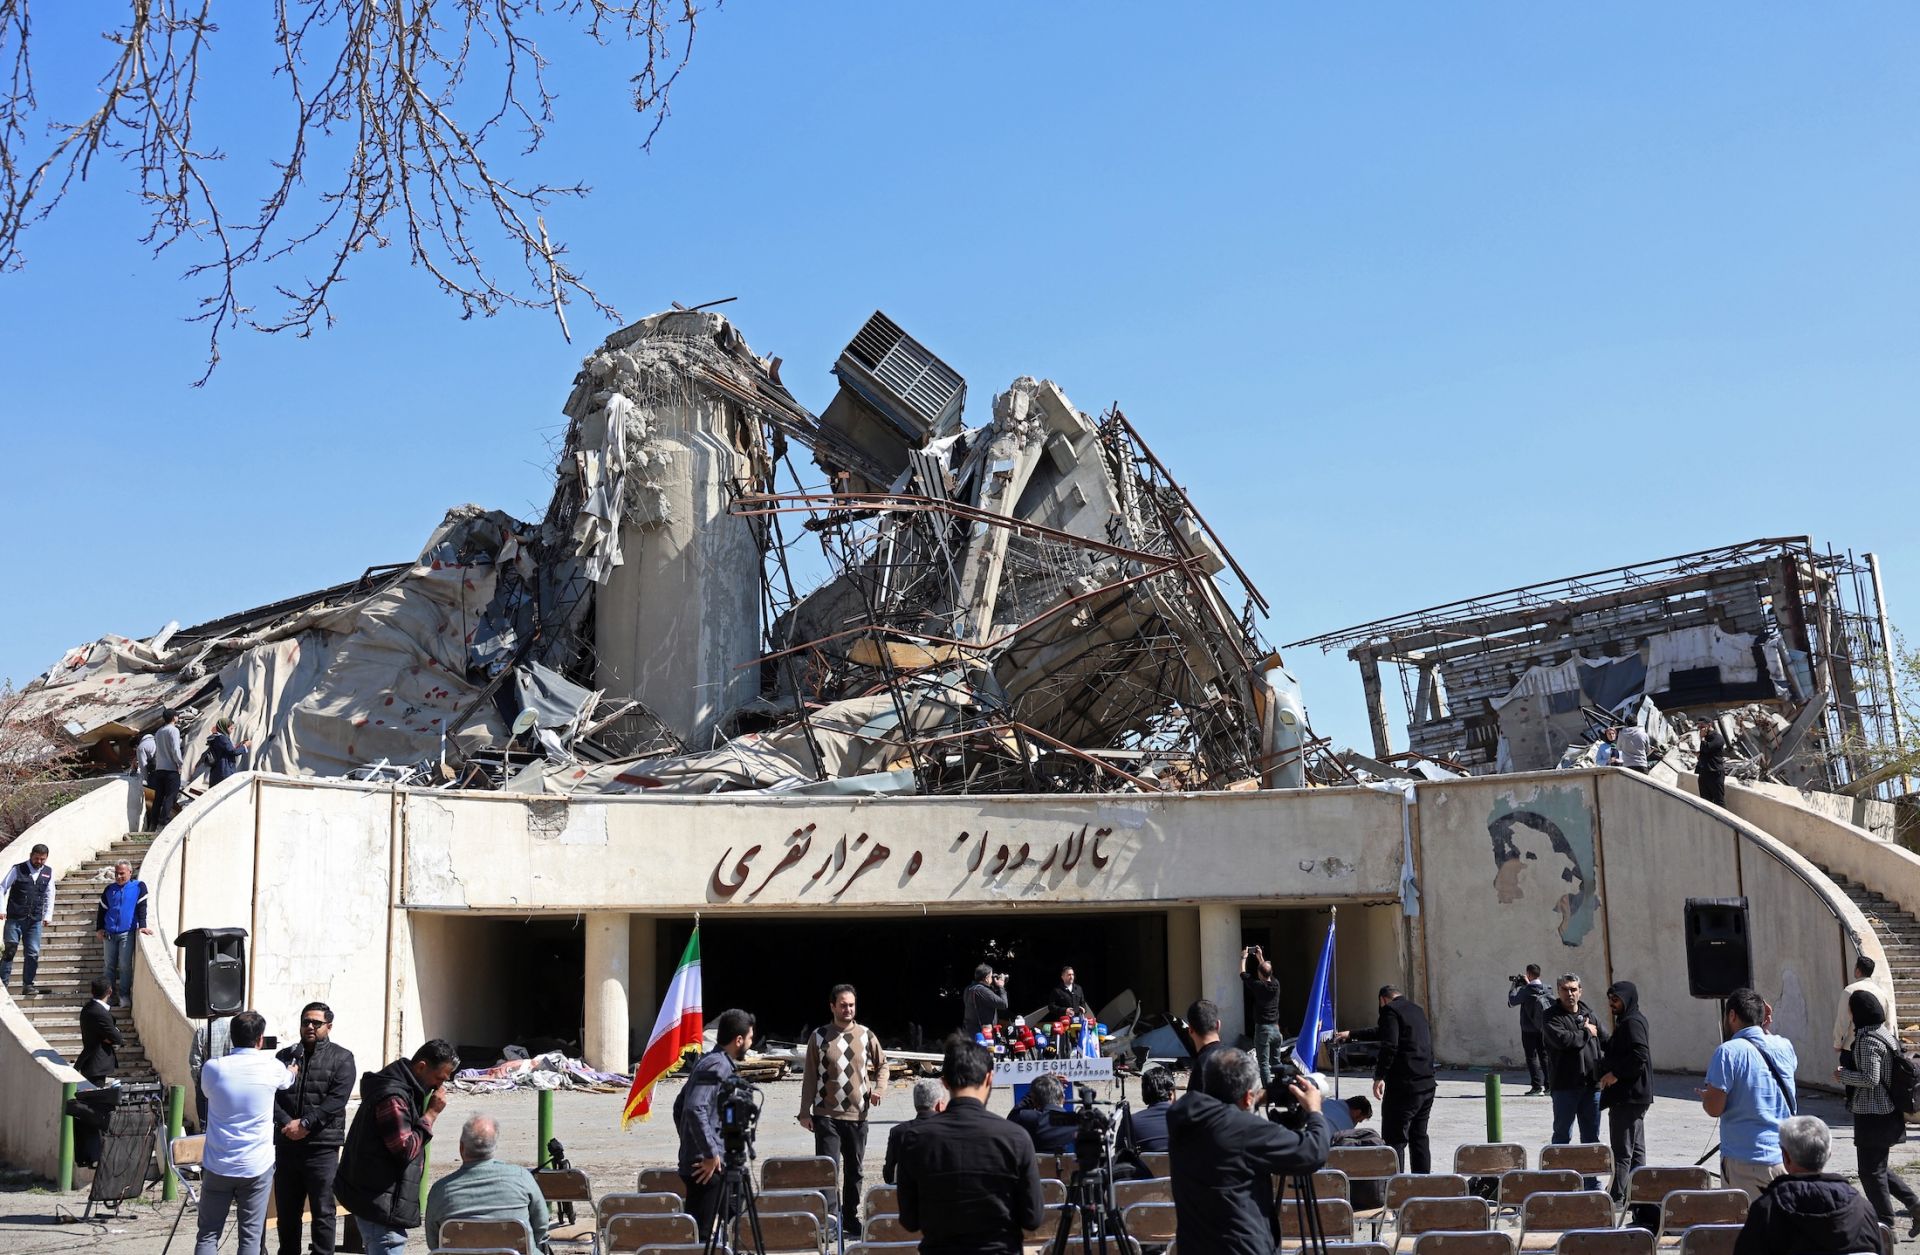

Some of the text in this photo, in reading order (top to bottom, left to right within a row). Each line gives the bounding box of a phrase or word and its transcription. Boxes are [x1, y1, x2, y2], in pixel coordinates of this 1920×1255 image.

[712, 822, 817, 897] نفری
[812, 832, 891, 897] هزار
[1041, 822, 1113, 872] تالار
[995, 1060, 1090, 1073] FC ESTEGHLAL
[1048, 1069, 1110, 1077] POKESPERSON
